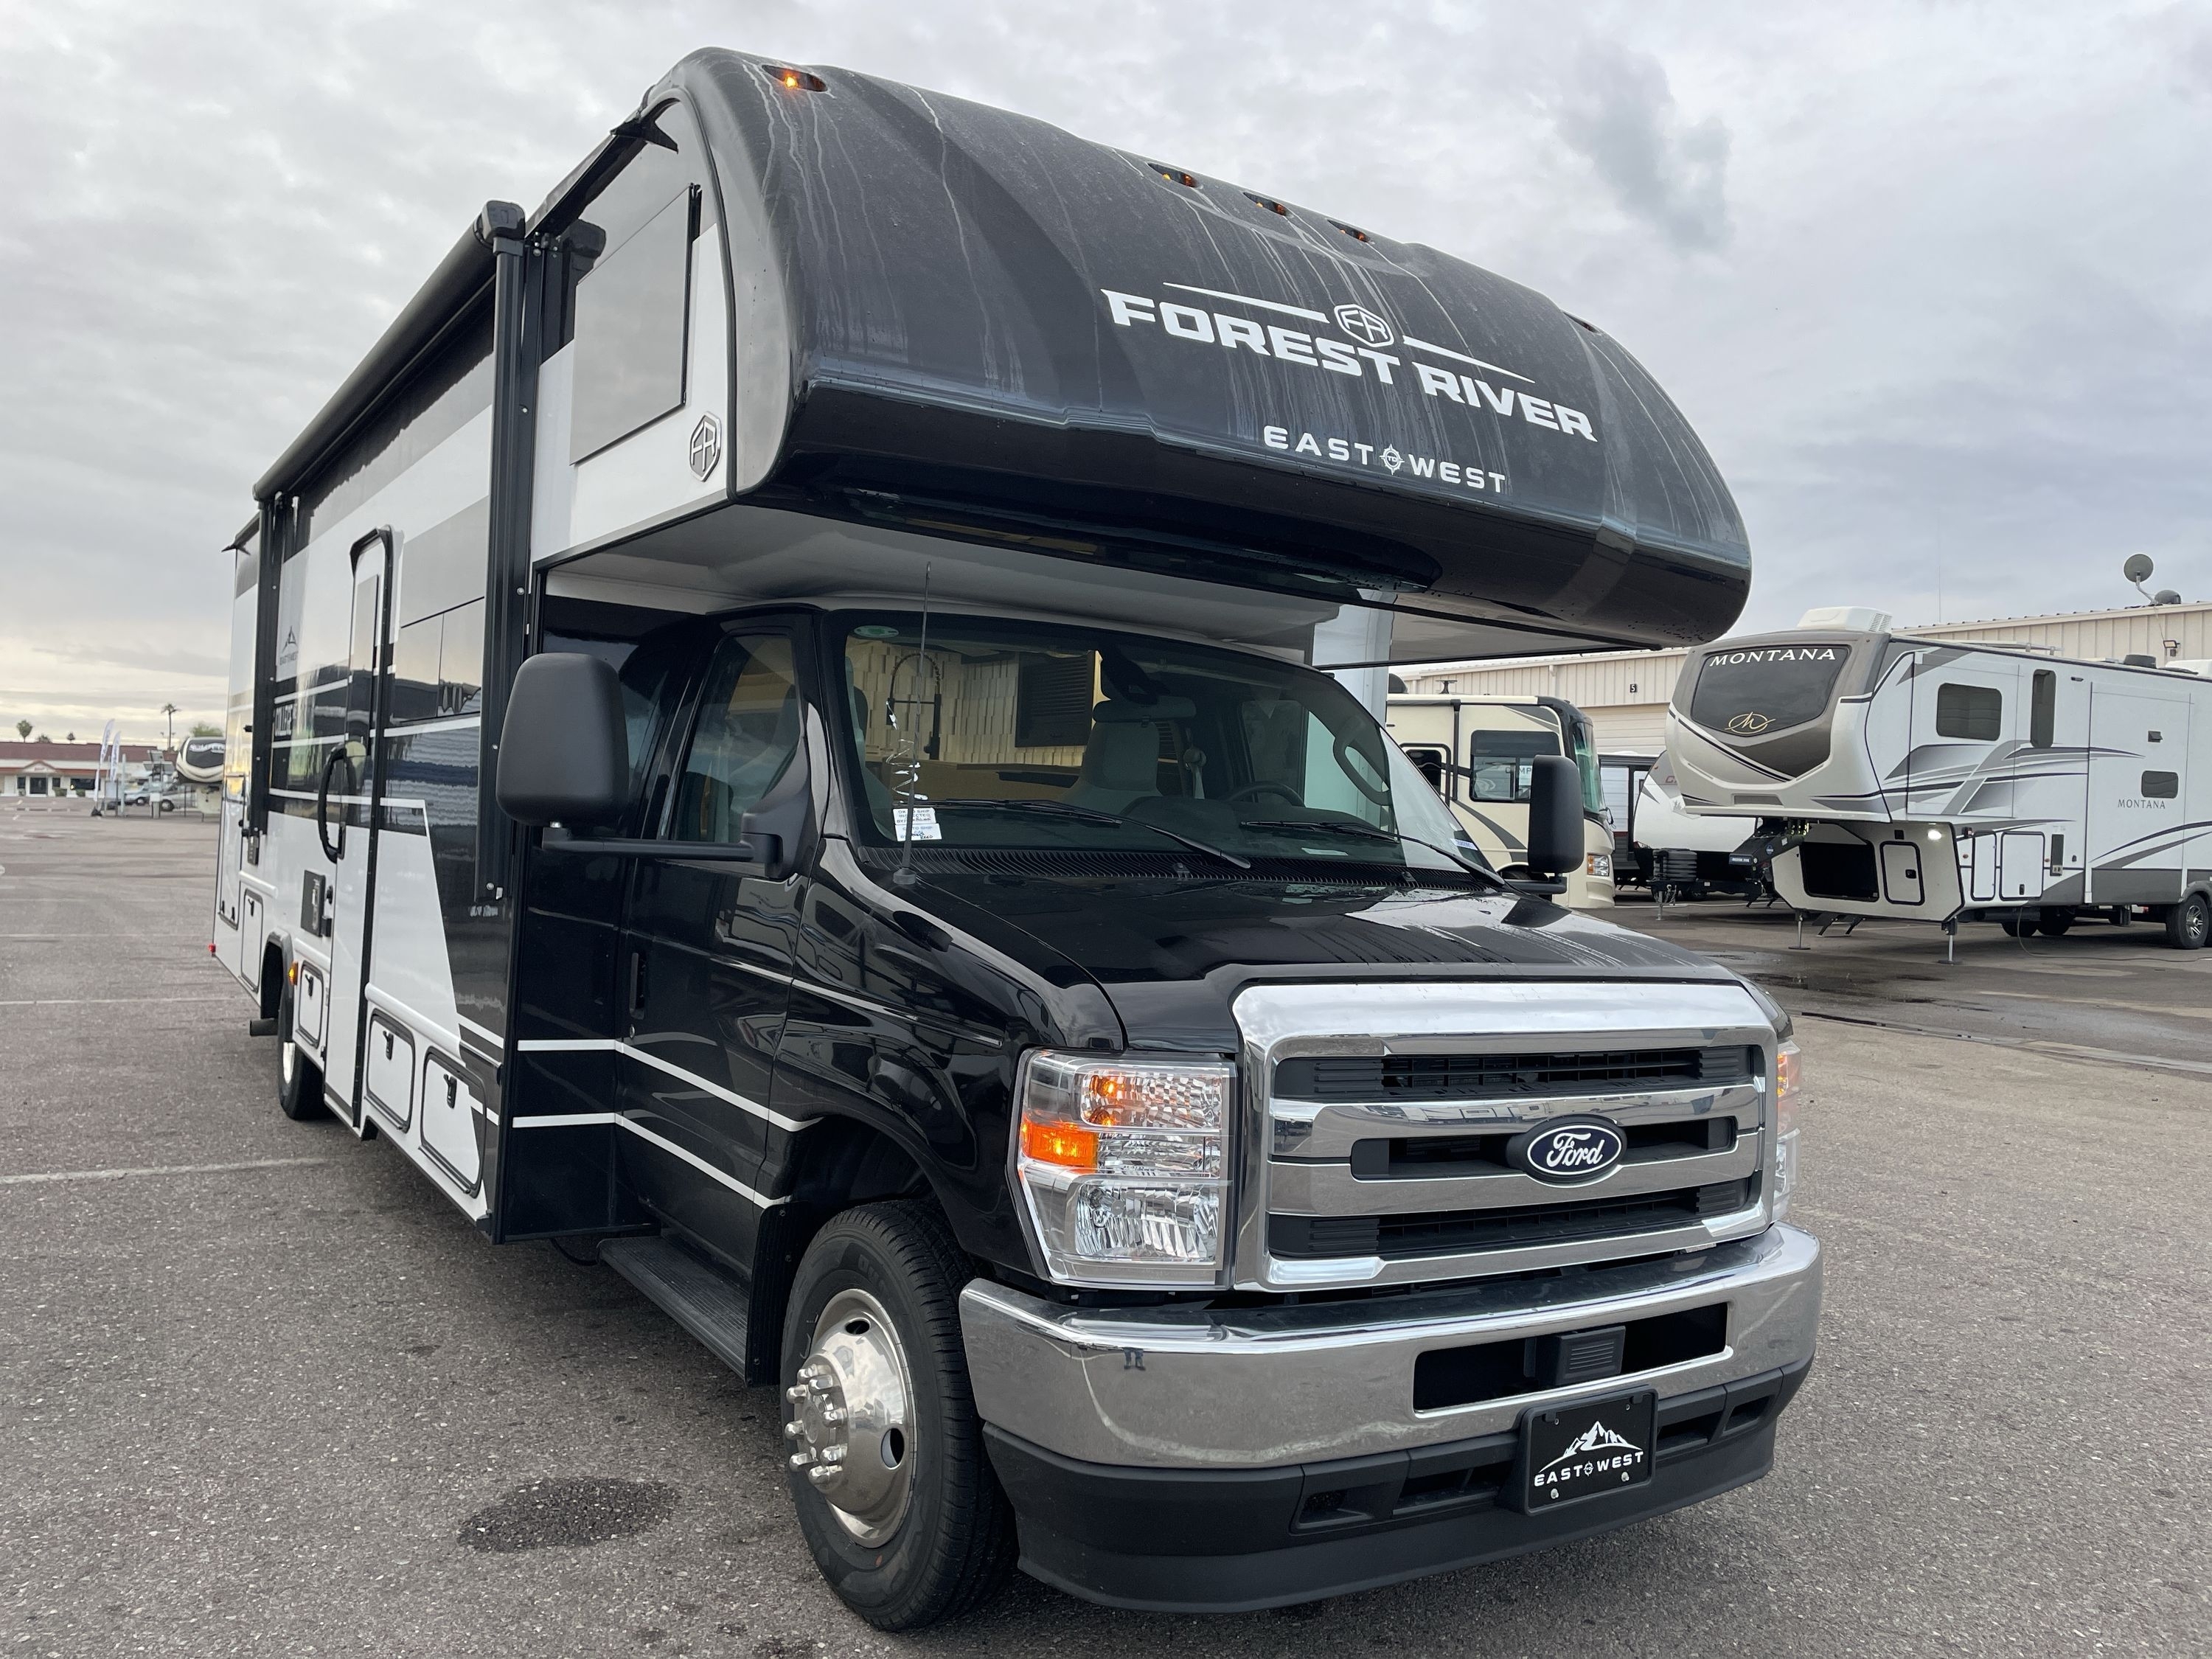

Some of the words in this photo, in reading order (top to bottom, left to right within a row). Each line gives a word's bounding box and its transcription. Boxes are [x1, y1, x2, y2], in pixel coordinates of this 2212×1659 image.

[1100, 288, 1401, 385] FOREST
[1411, 361, 1599, 442] RIVER
[1263, 425, 1374, 465] EAST
[1408, 453, 1506, 493] WEST
[1708, 648, 1837, 667] MONTANA
[2118, 799, 2166, 810] MONTANA
[1546, 1133, 1605, 1167] Ford
[1534, 1464, 1583, 1487] EAST
[1596, 1451, 1644, 1472] WEST
